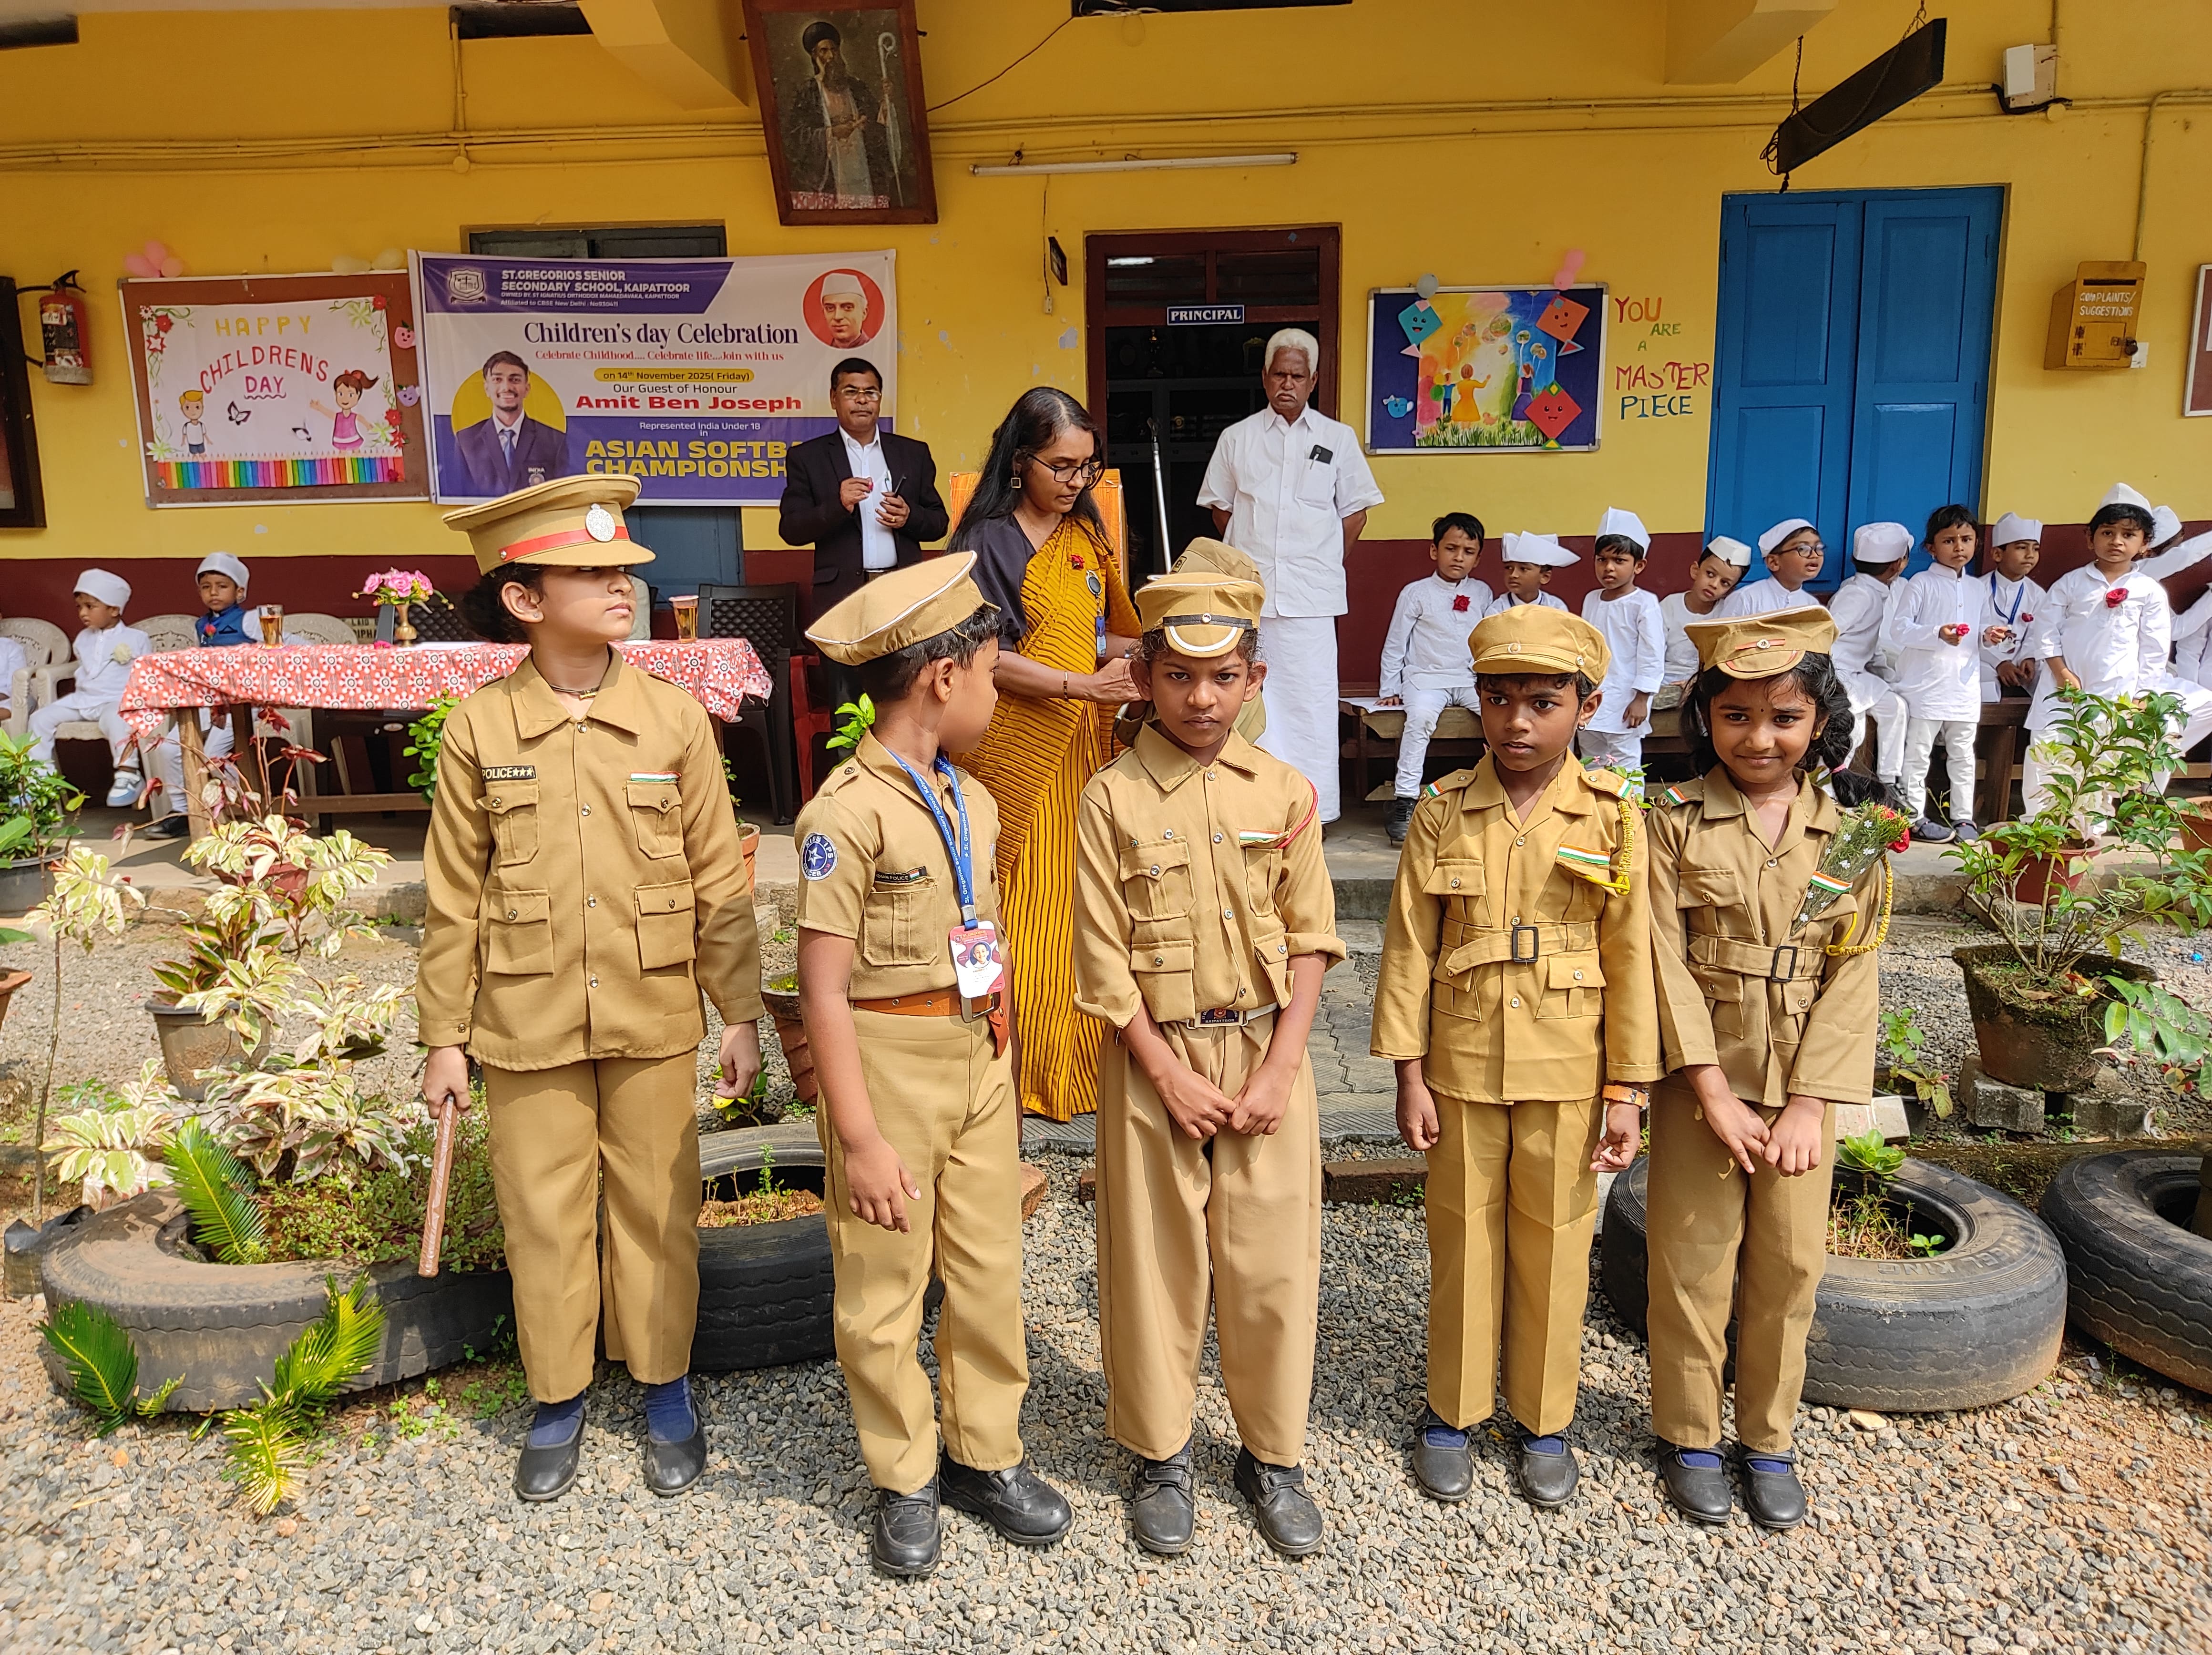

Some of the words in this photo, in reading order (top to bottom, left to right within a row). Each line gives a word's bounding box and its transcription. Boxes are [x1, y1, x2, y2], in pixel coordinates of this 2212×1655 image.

[584, 270, 625, 281] SENIOR
[501, 281, 571, 292] SECONDARY
[574, 282, 622, 293] SCHOOL,
[624, 283, 690, 292] KAIPATTOOR
[1171, 310, 1241, 321] PRINCIPAL
[1615, 296, 1662, 323] YOU
[2079, 306, 2133, 317] SUGGESTIONS
[215, 316, 310, 336] HAPPY
[1650, 323, 1681, 336] ARE
[524, 322, 632, 343] Children's
[636, 323, 671, 349] day
[677, 323, 799, 344] Celebration
[1637, 340, 1647, 351] A
[536, 350, 581, 360] Celebrate
[648, 351, 694, 360] Celebrate
[745, 351, 768, 360] with
[717, 372, 749, 382] Friday)
[1616, 361, 1710, 391] MASTER
[245, 376, 284, 393] DAY
[614, 384, 635, 393] Our
[638, 384, 674, 393] Guest
[677, 384, 689, 393] of
[694, 385, 738, 393] Honour
[576, 395, 640, 409] Amit
[649, 397, 699, 409] Ben
[708, 397, 802, 413] Joseph
[1621, 394, 1693, 420] PIECE
[640, 422, 696, 431] Represented
[585, 440, 679, 458] ASIAN
[688, 441, 803, 459] SOFTB
[481, 767, 513, 779] POLICE
[939, 816, 953, 846] Secondary
[823, 842, 833, 859] IPS
[958, 866, 968, 895] Gregorios
[1877, 1262, 1956, 1276] KING
